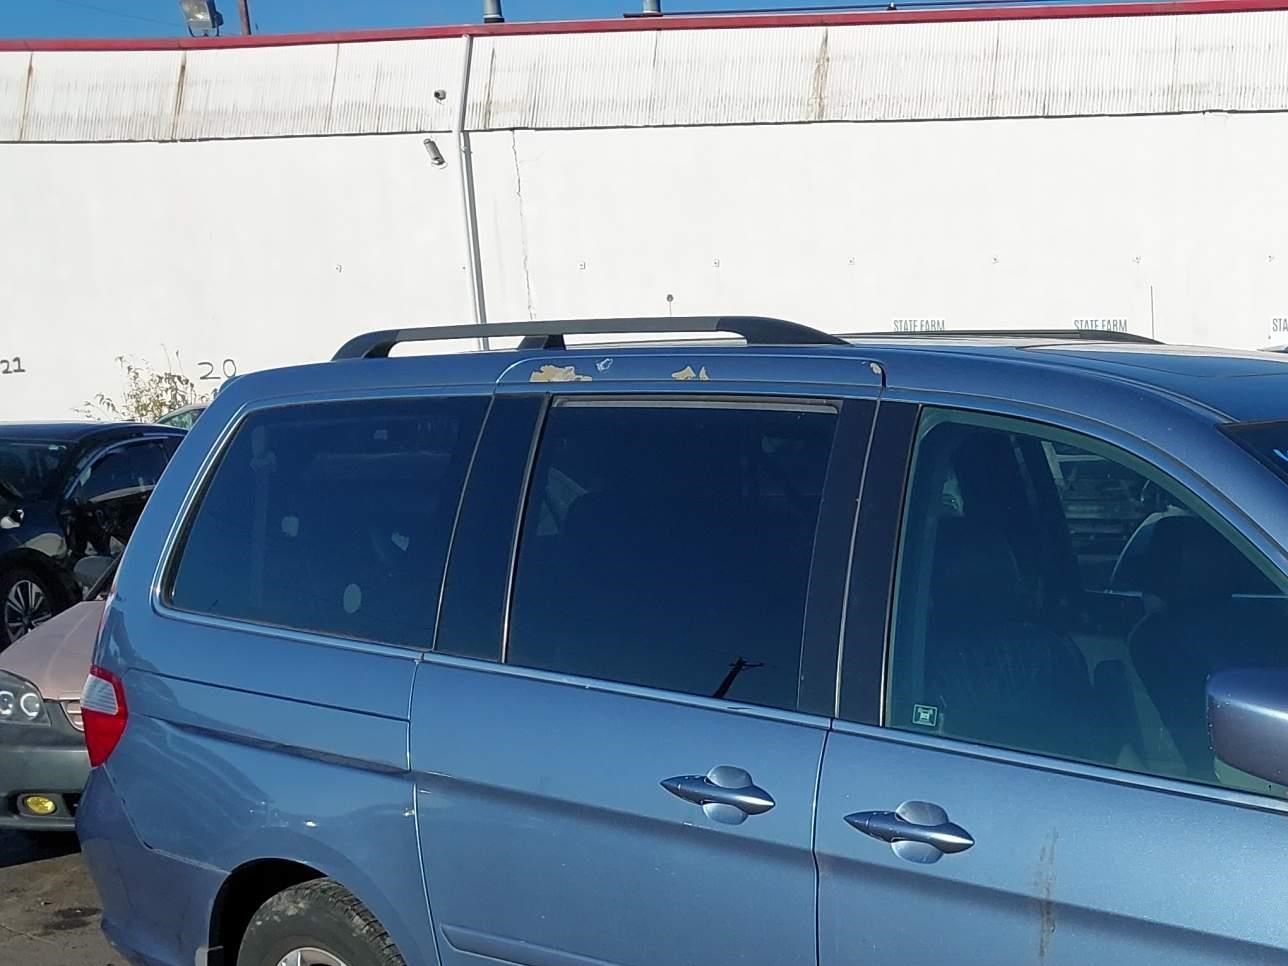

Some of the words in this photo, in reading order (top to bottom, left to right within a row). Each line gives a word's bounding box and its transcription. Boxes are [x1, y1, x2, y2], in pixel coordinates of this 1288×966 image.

[893, 319, 918, 331] STATE
[920, 319, 945, 331] FARM
[1074, 319, 1099, 331] STATE
[1101, 319, 1128, 332] FARM
[0, 357, 26, 374] 21
[197, 358, 237, 380] 20
